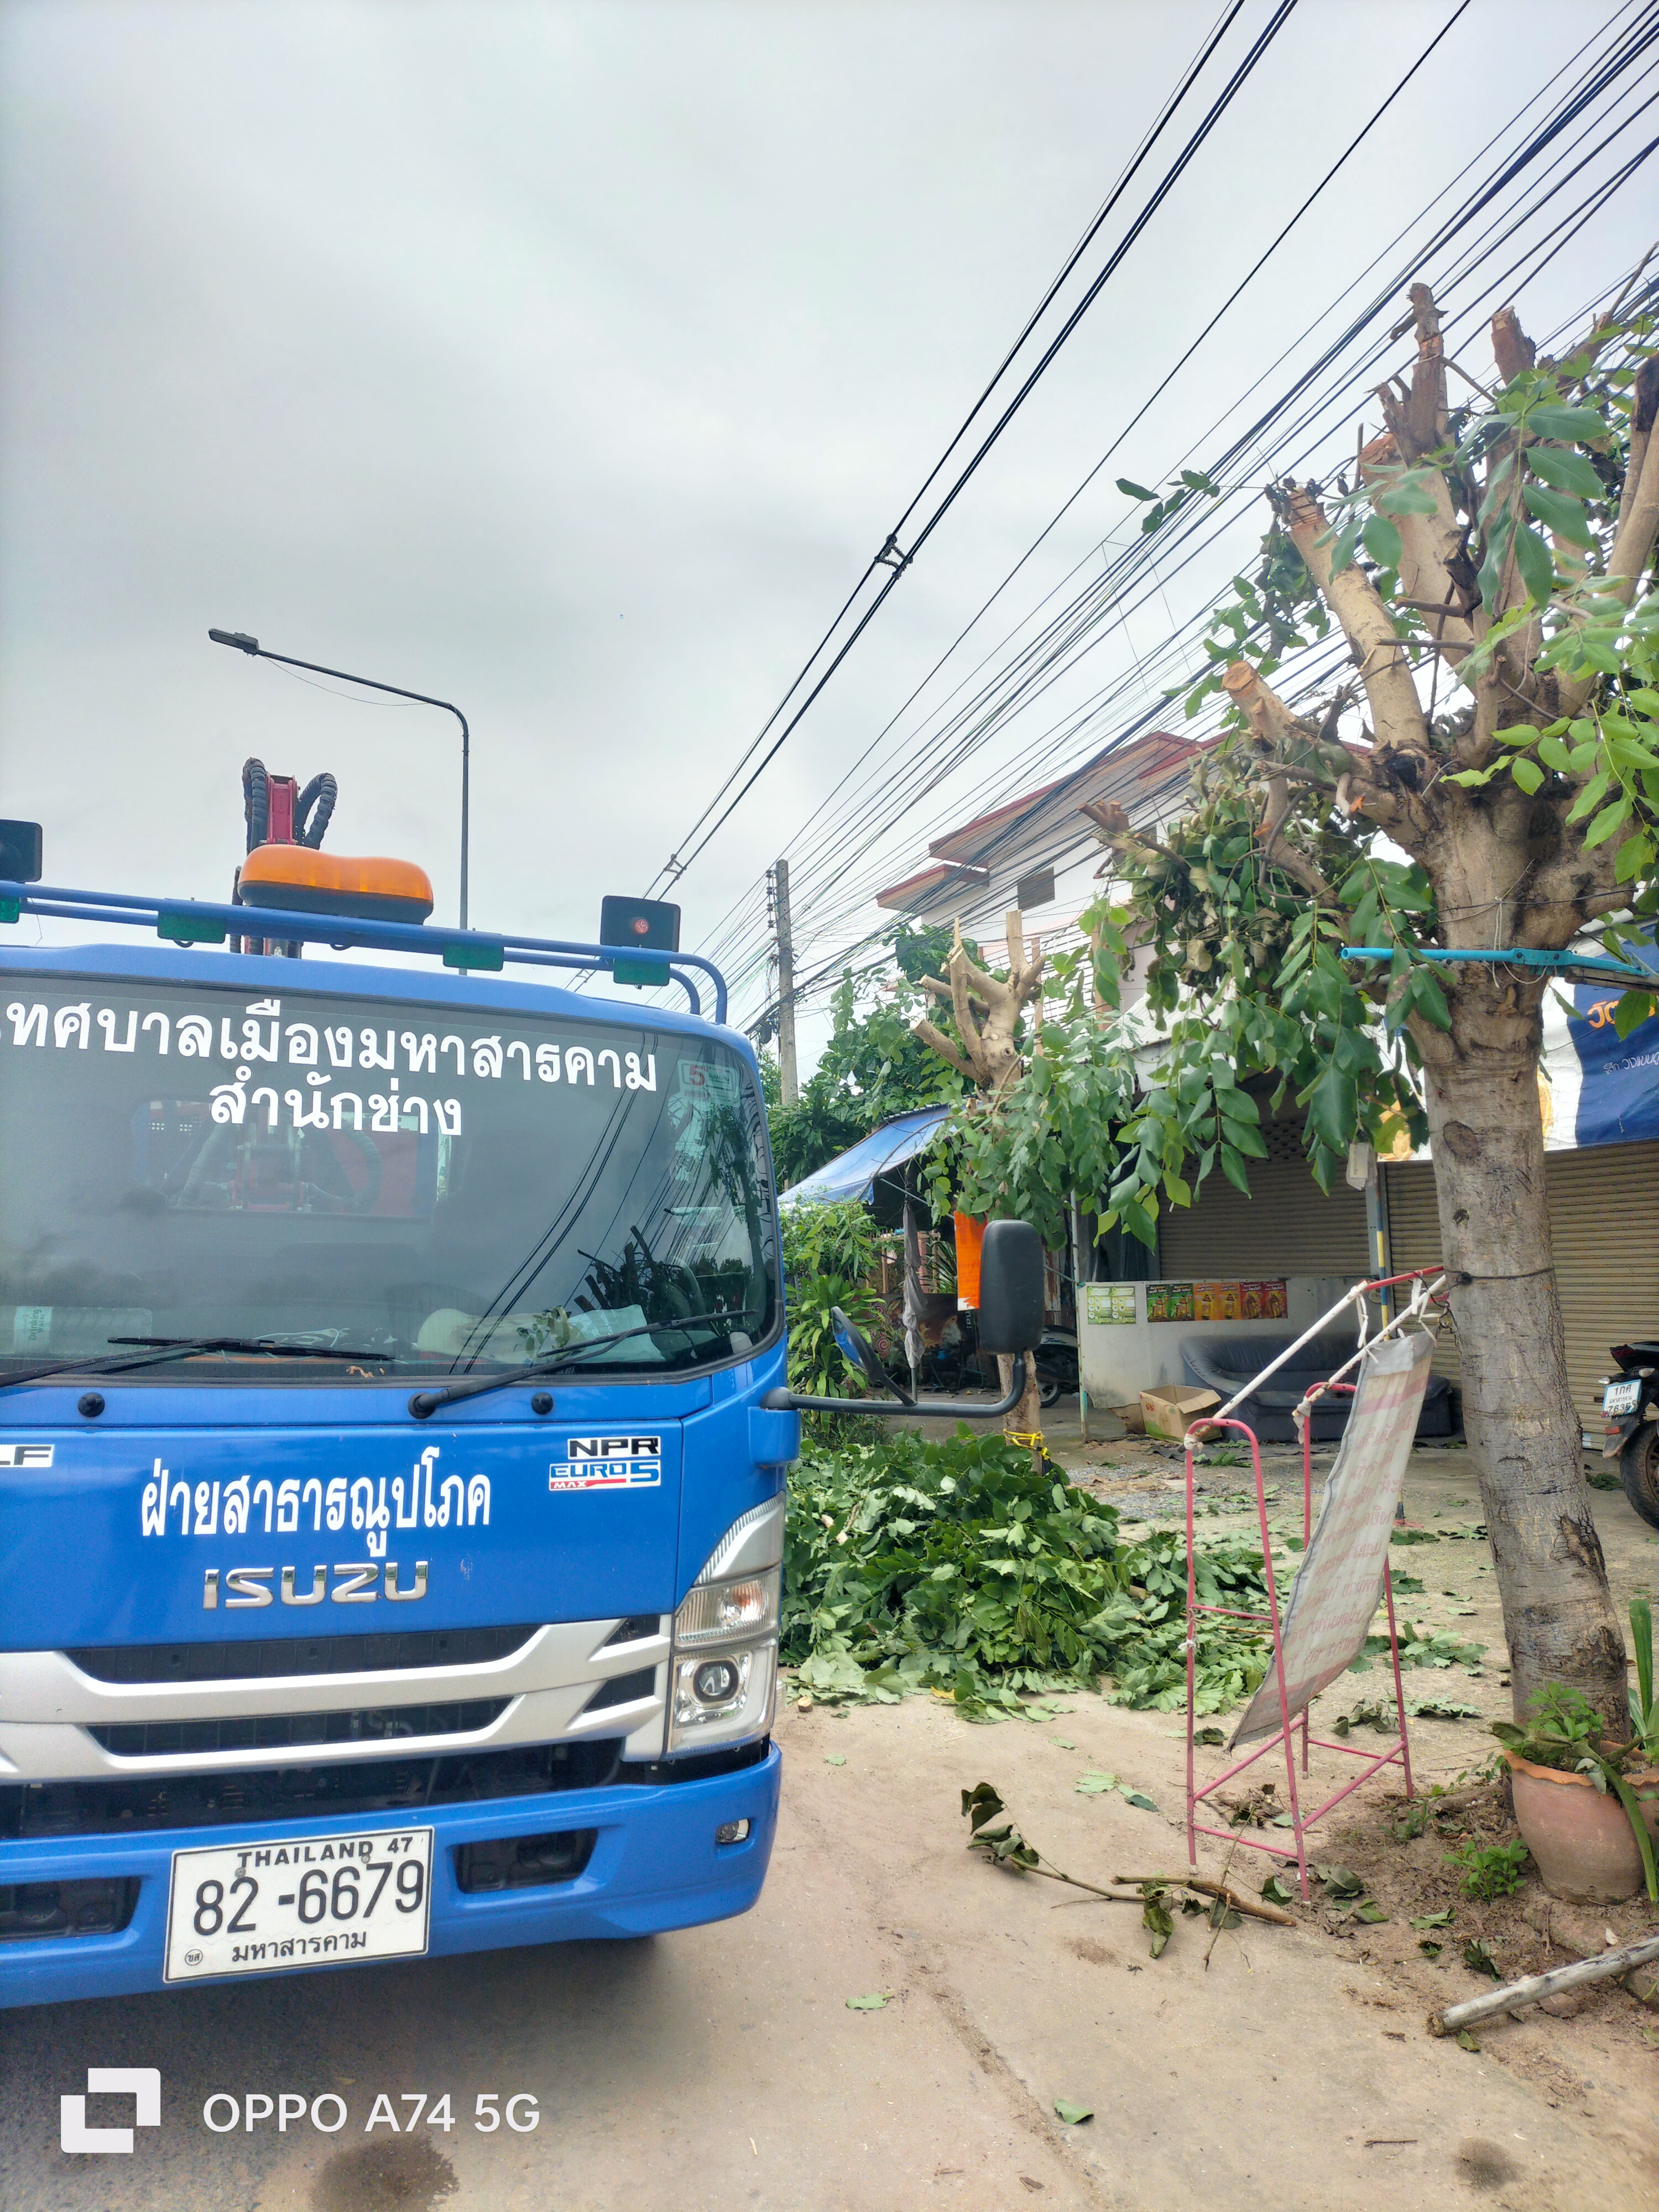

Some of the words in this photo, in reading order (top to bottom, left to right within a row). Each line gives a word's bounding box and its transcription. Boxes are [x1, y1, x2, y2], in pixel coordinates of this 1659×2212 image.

[0, 999, 657, 1091] ทศบาลเมืองมหาสารคาม
[210, 1066, 462, 1136] สำนักช่าง
[570, 1438, 659, 1457] NPR
[141, 1446, 491, 1557] ฝ่ายสาธารณูปโภค
[202, 1561, 429, 1609] ISUZU
[238, 1840, 373, 1867] THAILAND
[388, 1837, 413, 1853] 47
[194, 1859, 424, 1936] 82-6679
[232, 1931, 367, 1962] มหาสารคาม
